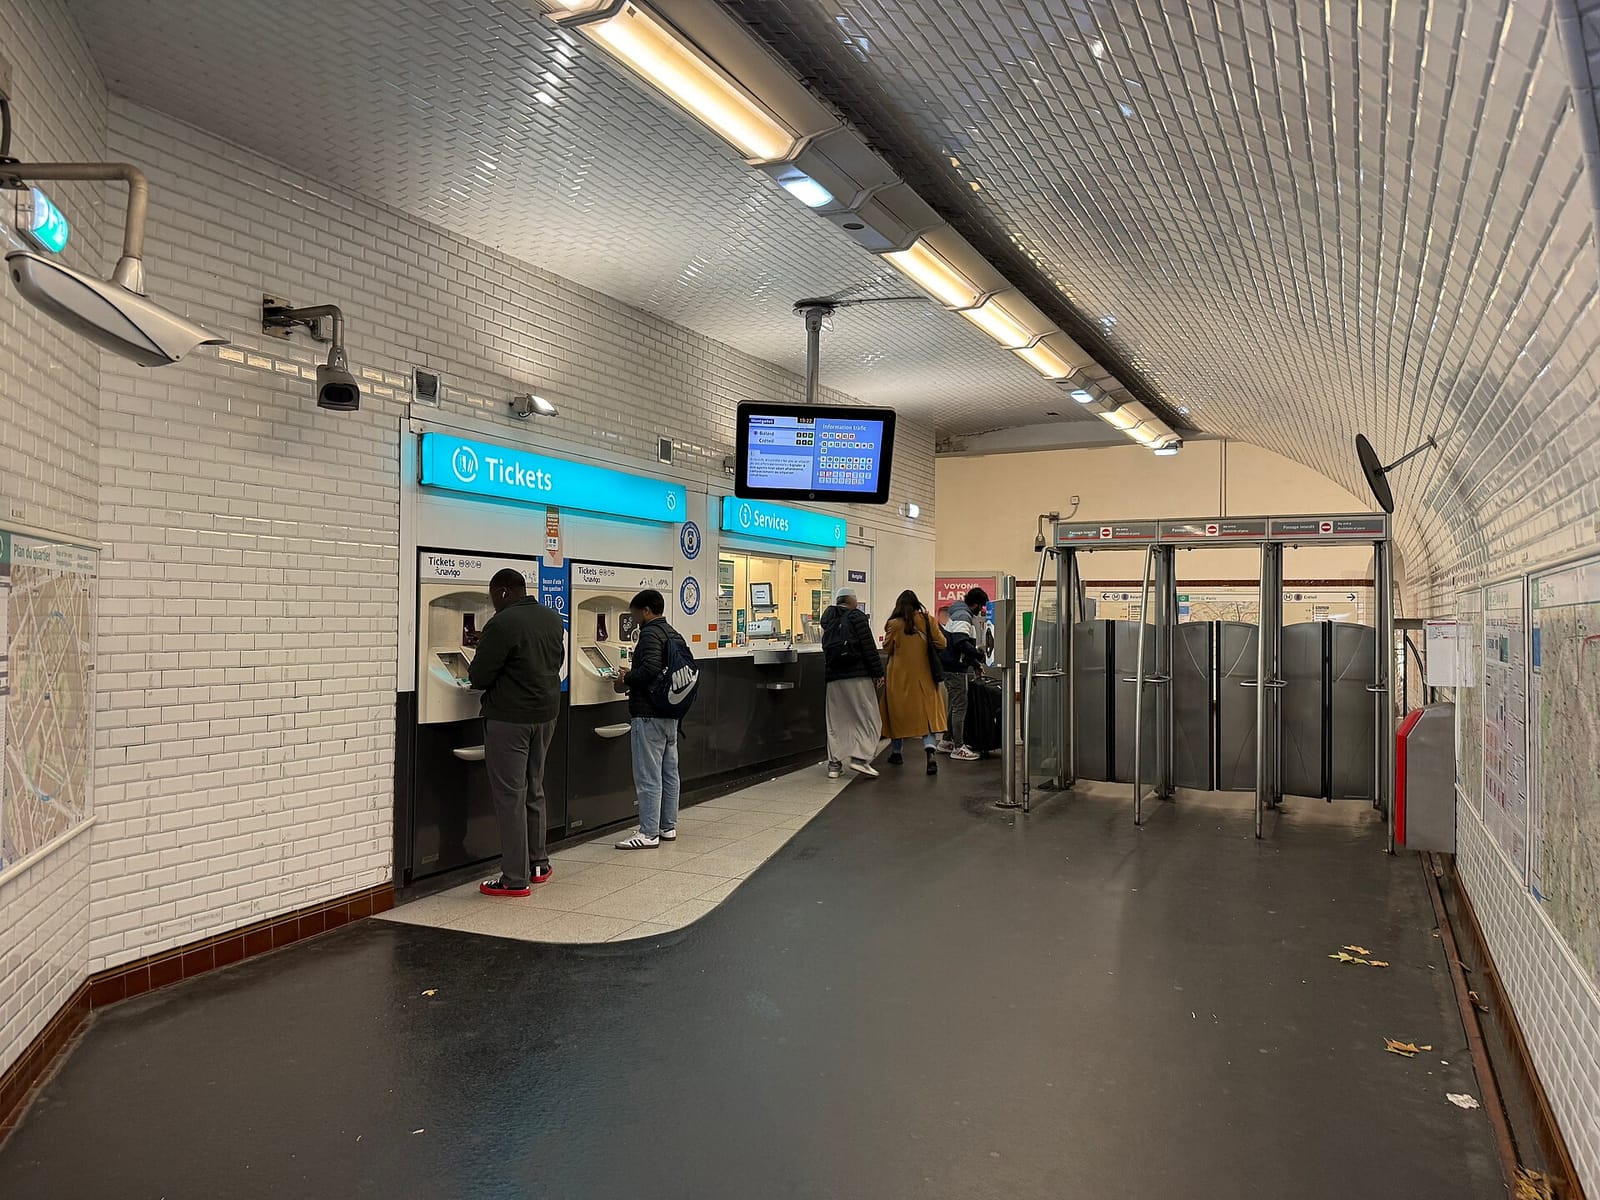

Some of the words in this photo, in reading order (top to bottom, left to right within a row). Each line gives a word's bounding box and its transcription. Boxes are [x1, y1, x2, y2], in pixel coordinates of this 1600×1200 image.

[484, 456, 552, 491] Tickets
[754, 510, 789, 532] Services
[14, 544, 25, 558] Plan
[26, 547, 32, 559] du
[428, 556, 455, 567] Tickets
[578, 566, 597, 576] Tickets
